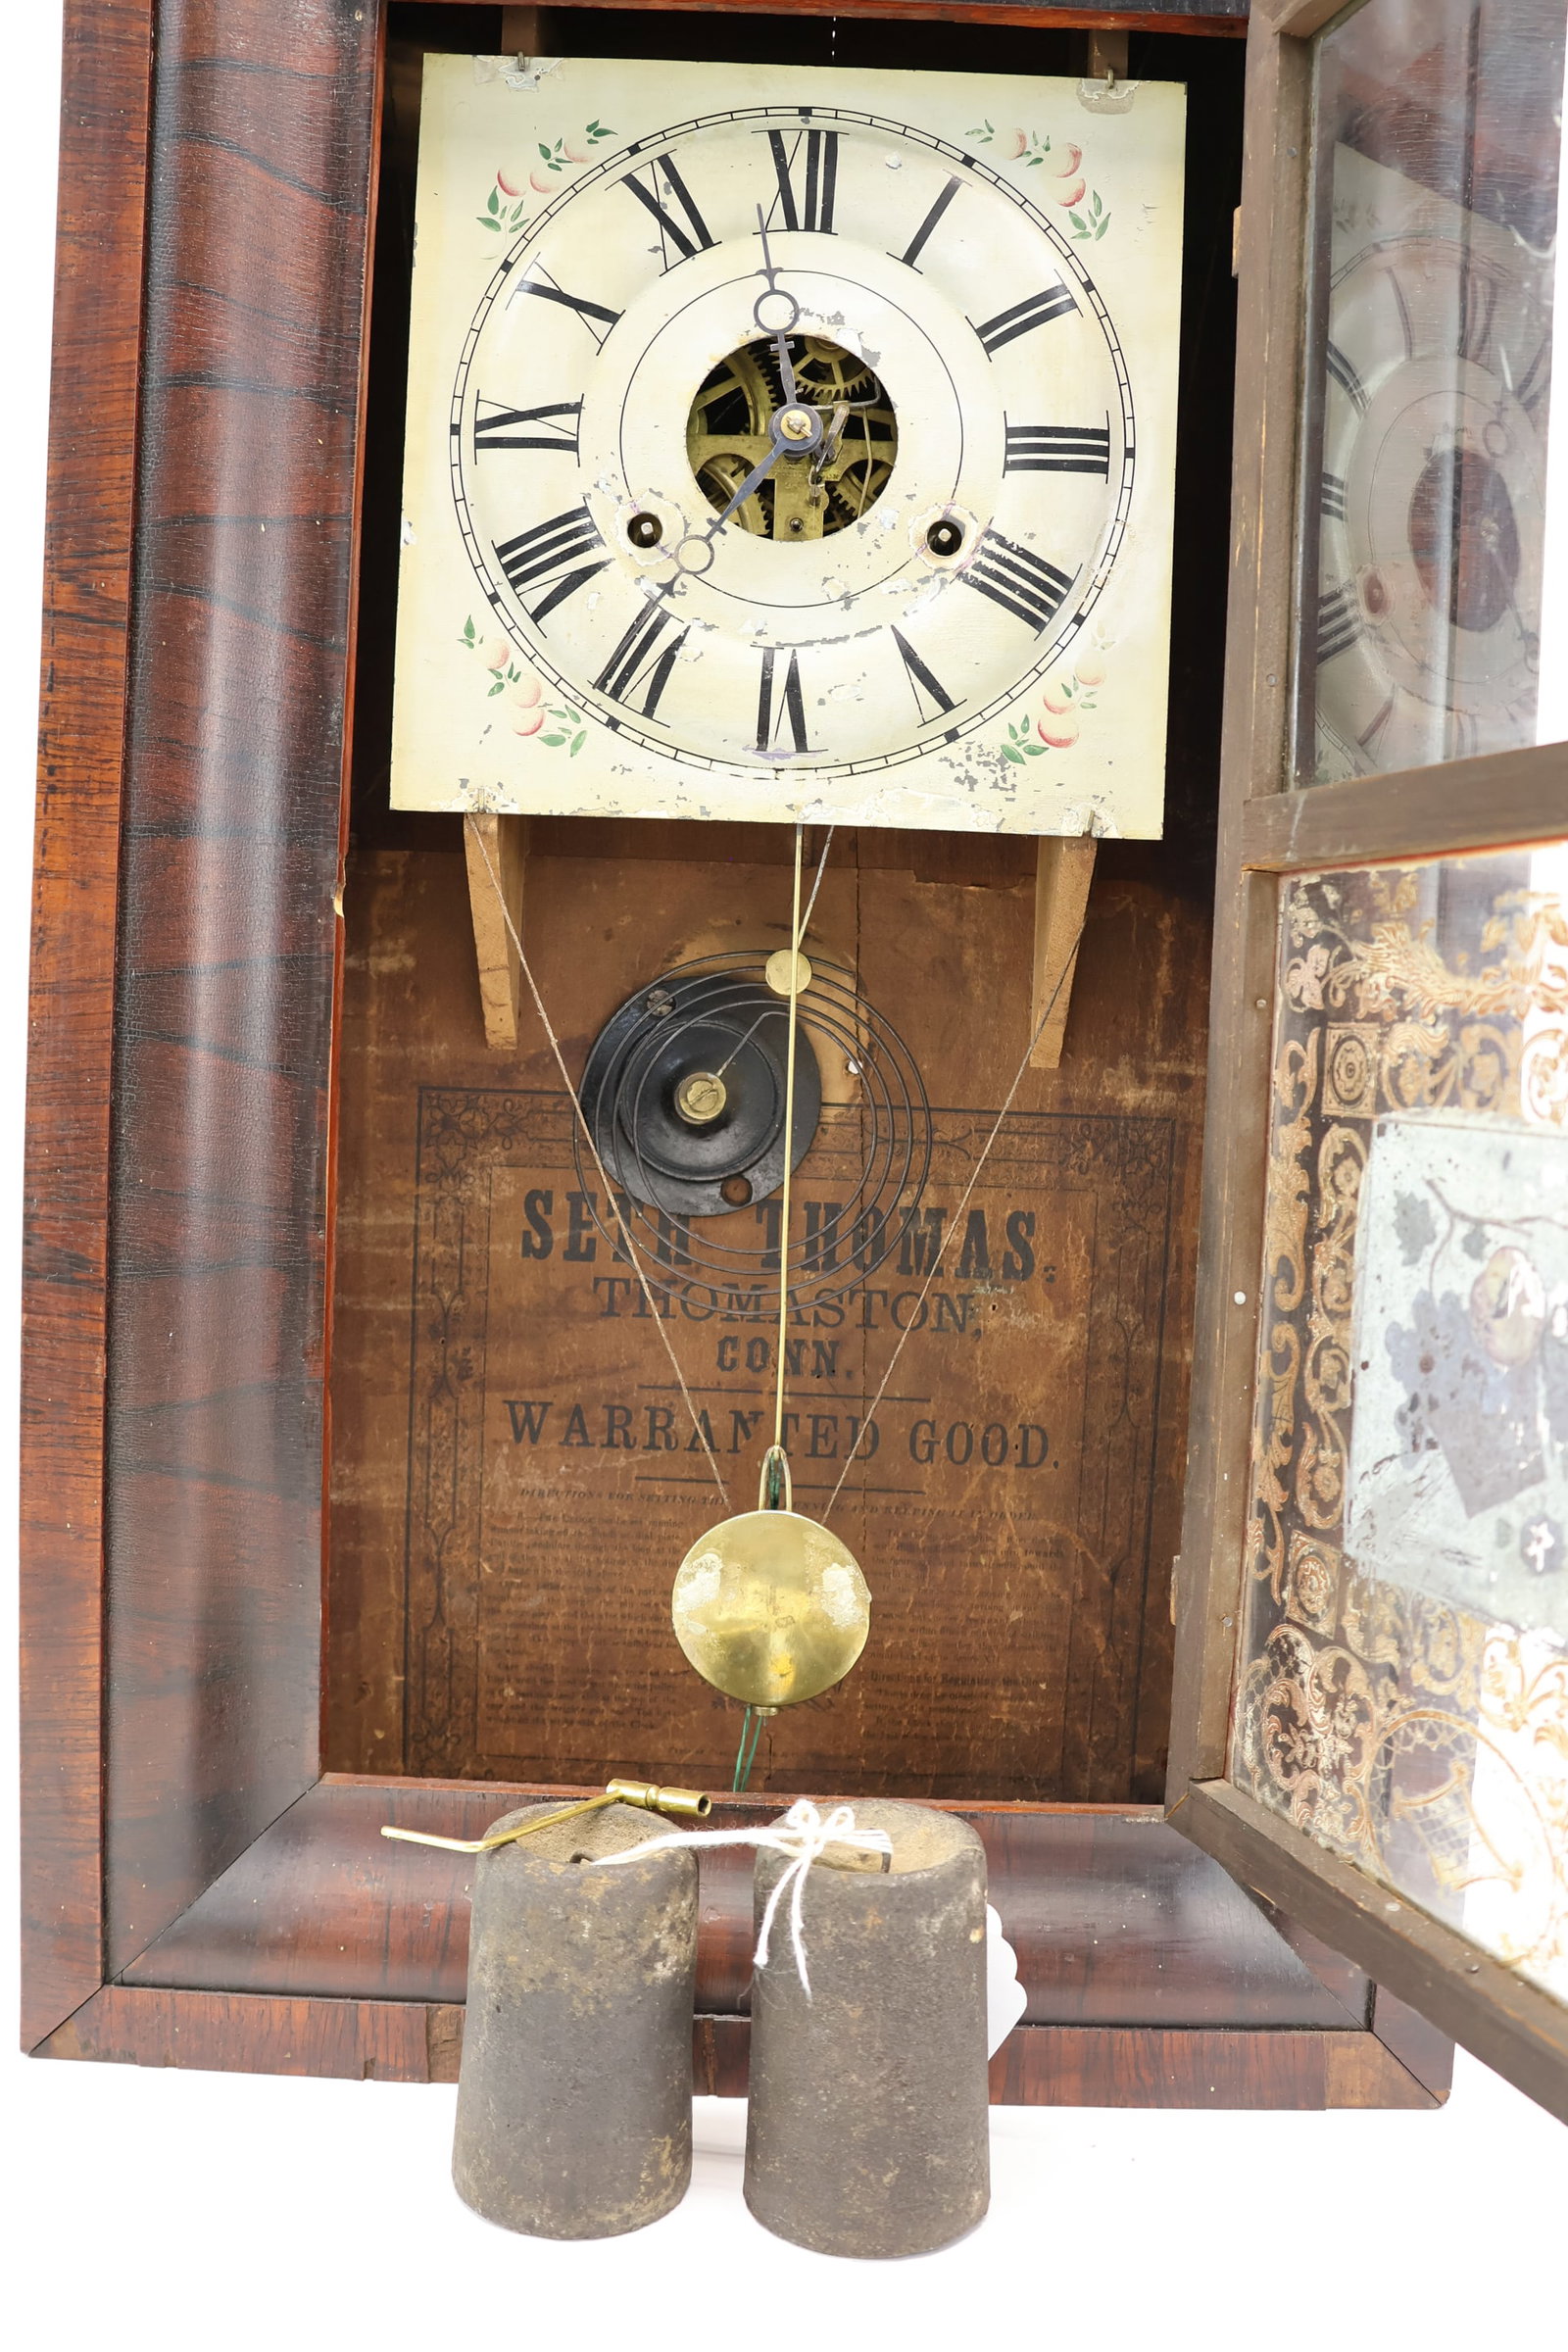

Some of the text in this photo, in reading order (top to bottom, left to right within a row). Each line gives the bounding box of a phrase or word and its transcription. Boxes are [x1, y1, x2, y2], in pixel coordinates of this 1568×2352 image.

[607, 151, 721, 275] XI
[752, 129, 848, 235] XII
[886, 170, 972, 274] I
[508, 252, 624, 356] X
[965, 270, 1084, 362] II
[474, 389, 584, 466] IX
[1003, 410, 1110, 484] III
[492, 498, 616, 638] VIII
[959, 517, 1084, 641] IIII
[588, 597, 690, 726] VII
[745, 645, 828, 753] VI
[892, 624, 967, 727] V
[521, 1189, 692, 1265] SETH
[716, 1336, 854, 1380] CONN.
[504, 1399, 1059, 1470] WARRANTED GOOD.
